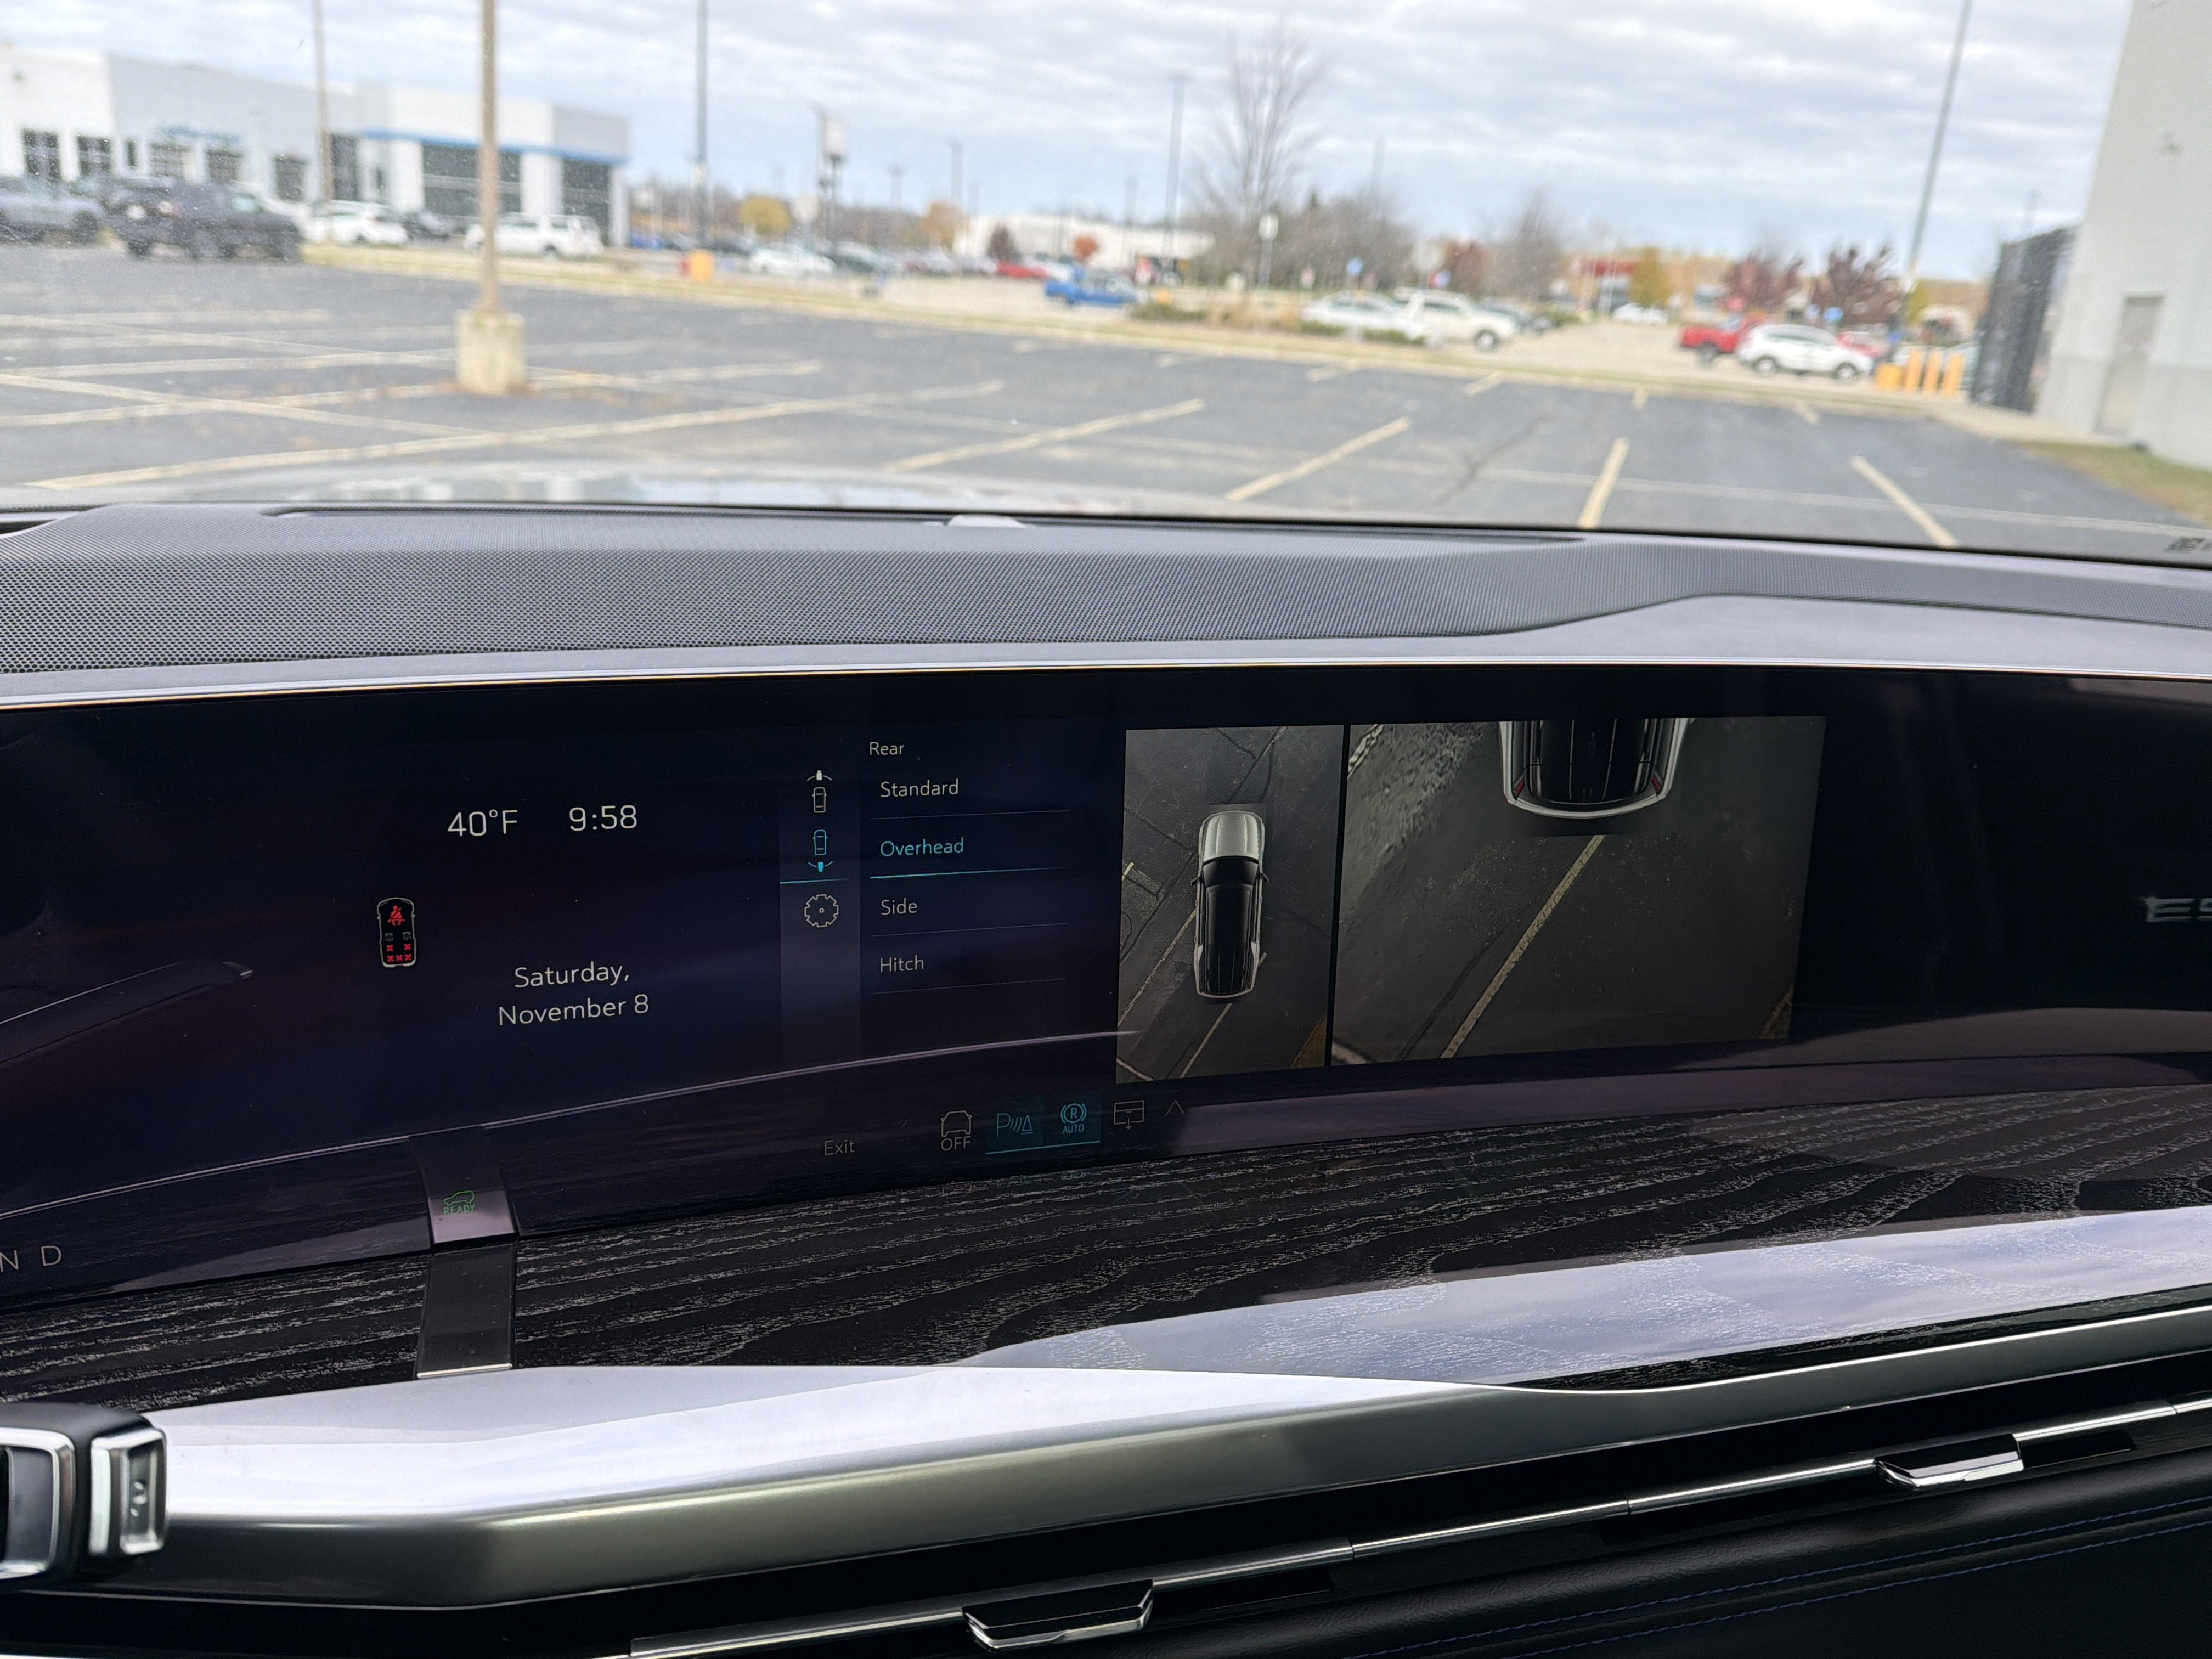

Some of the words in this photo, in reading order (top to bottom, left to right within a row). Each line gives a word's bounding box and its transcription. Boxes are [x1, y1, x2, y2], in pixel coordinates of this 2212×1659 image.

[869, 741, 905, 756] Rear
[880, 778, 959, 798] Standard
[447, 809, 518, 837] 40°F
[569, 804, 637, 831] 9:58
[880, 837, 964, 857] Overhead
[880, 898, 918, 915] Side
[2145, 896, 2212, 923] E
[879, 954, 924, 973] Hitch
[514, 961, 630, 988] Saturday,
[498, 998, 627, 1025] November
[634, 994, 649, 1014] 8
[1062, 1124, 1085, 1134] AUTO
[823, 1139, 856, 1156] Exit
[940, 1136, 972, 1152] OFF
[443, 1204, 476, 1215] READY
[0, 1250, 19, 1272] N
[41, 1245, 61, 1266] D
